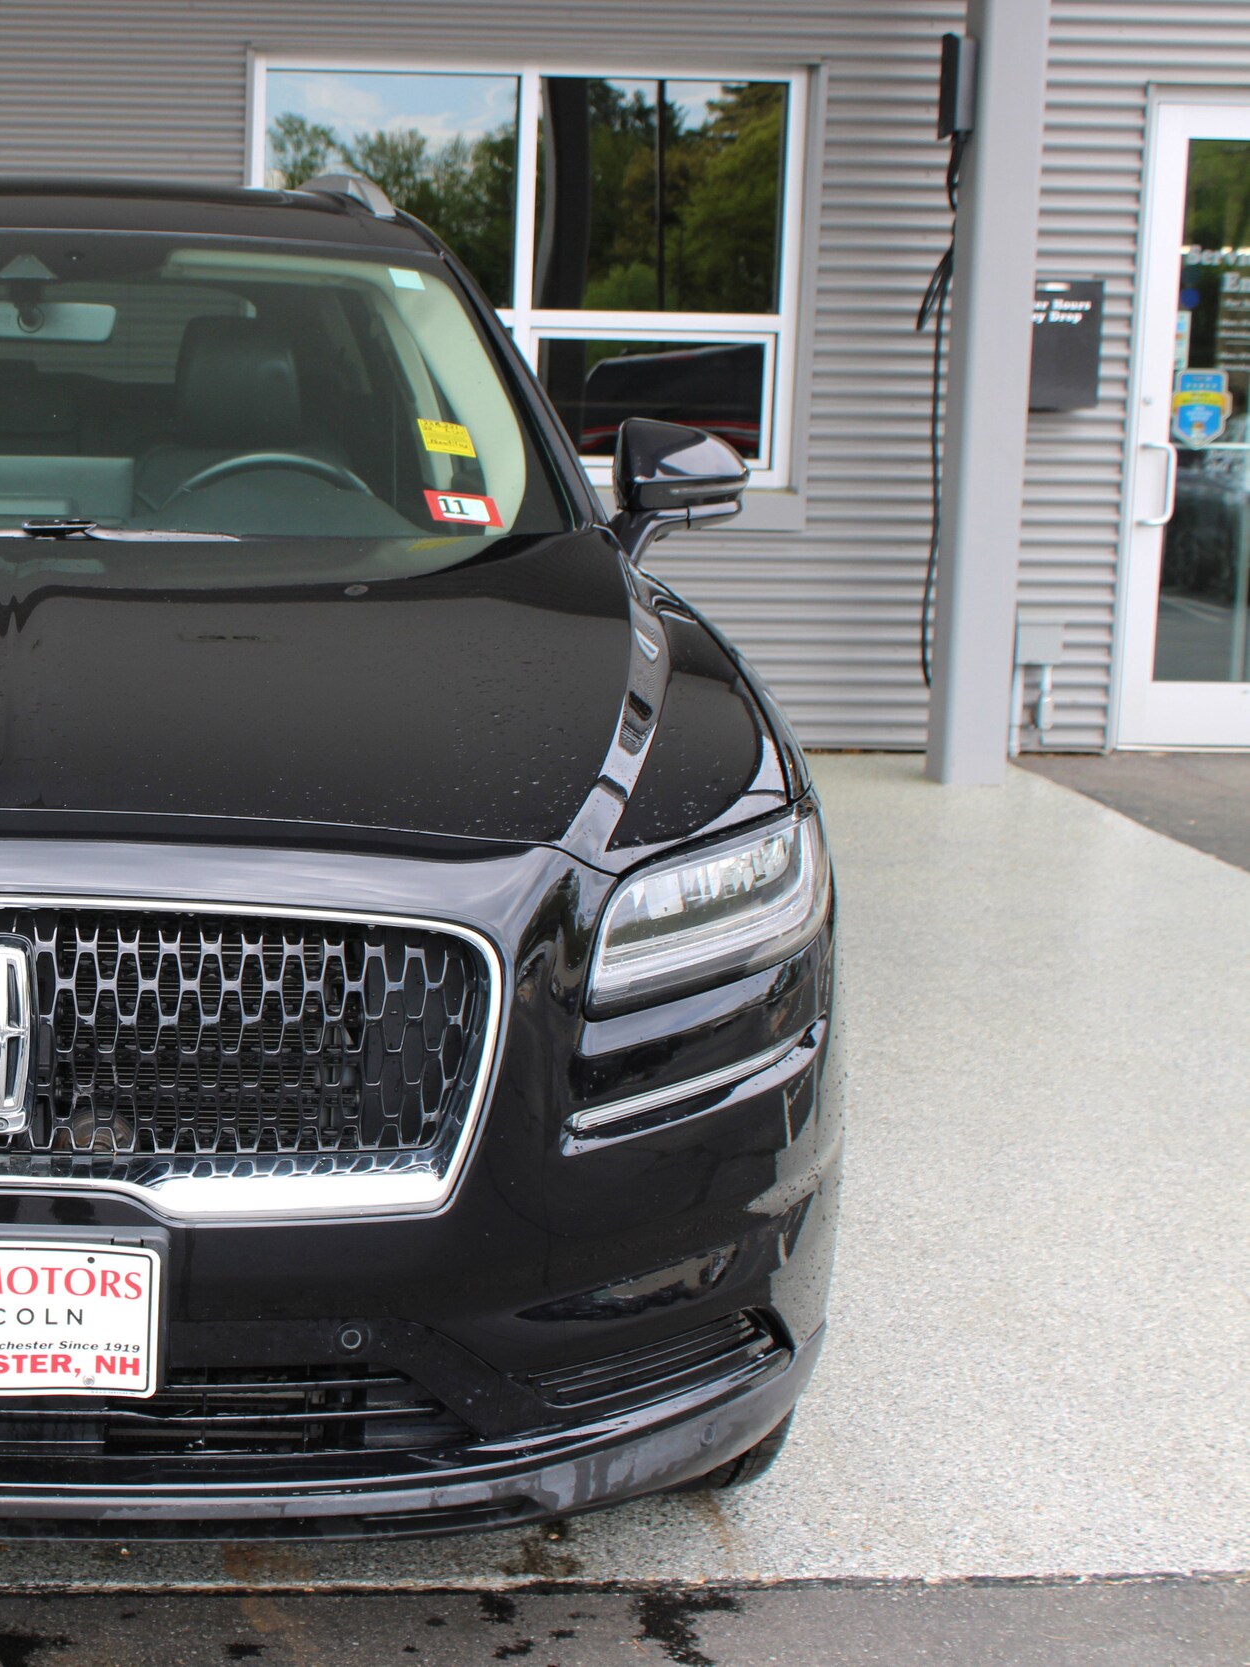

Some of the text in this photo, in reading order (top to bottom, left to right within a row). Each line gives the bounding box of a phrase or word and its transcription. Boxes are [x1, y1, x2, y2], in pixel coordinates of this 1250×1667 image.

[1052, 299, 1091, 311] Hours
[1049, 311, 1083, 324] Drop
[439, 498, 470, 515] 11
[58, 1340, 99, 1351] Since
[104, 1343, 140, 1353] 1919
[95, 1355, 140, 1376] NH
